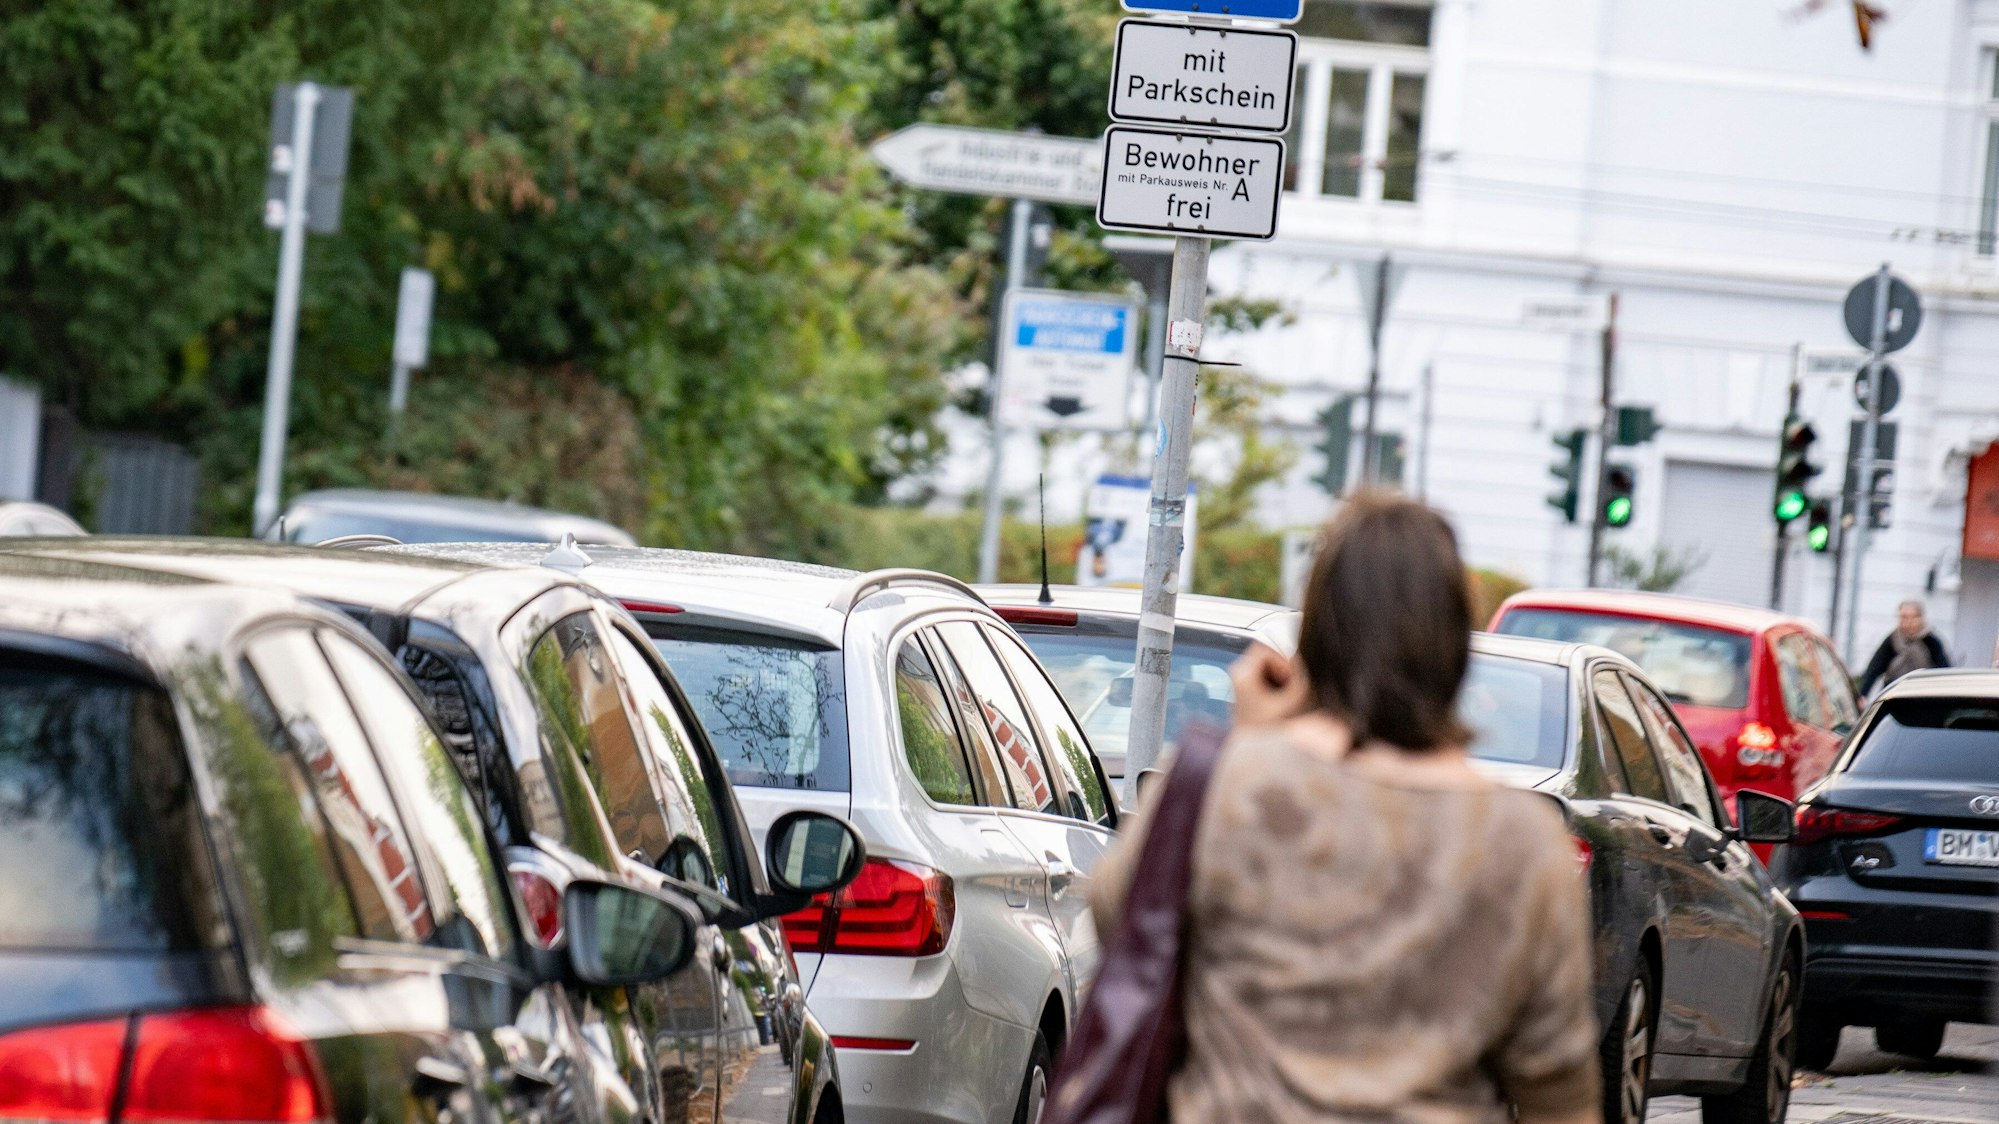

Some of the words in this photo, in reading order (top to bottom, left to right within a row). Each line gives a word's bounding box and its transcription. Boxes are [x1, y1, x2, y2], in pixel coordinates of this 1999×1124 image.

[1184, 49, 1226, 73] mit
[1128, 75, 1275, 110] Parkschein
[1125, 143, 1260, 176] Bewohner
[1118, 173, 1136, 184] mit
[1139, 173, 1208, 189] Parkausweis
[1213, 180, 1228, 191] Nr.
[1231, 178, 1250, 202] A
[1166, 193, 1211, 219] frei
[1942, 832, 1974, 857] BM
